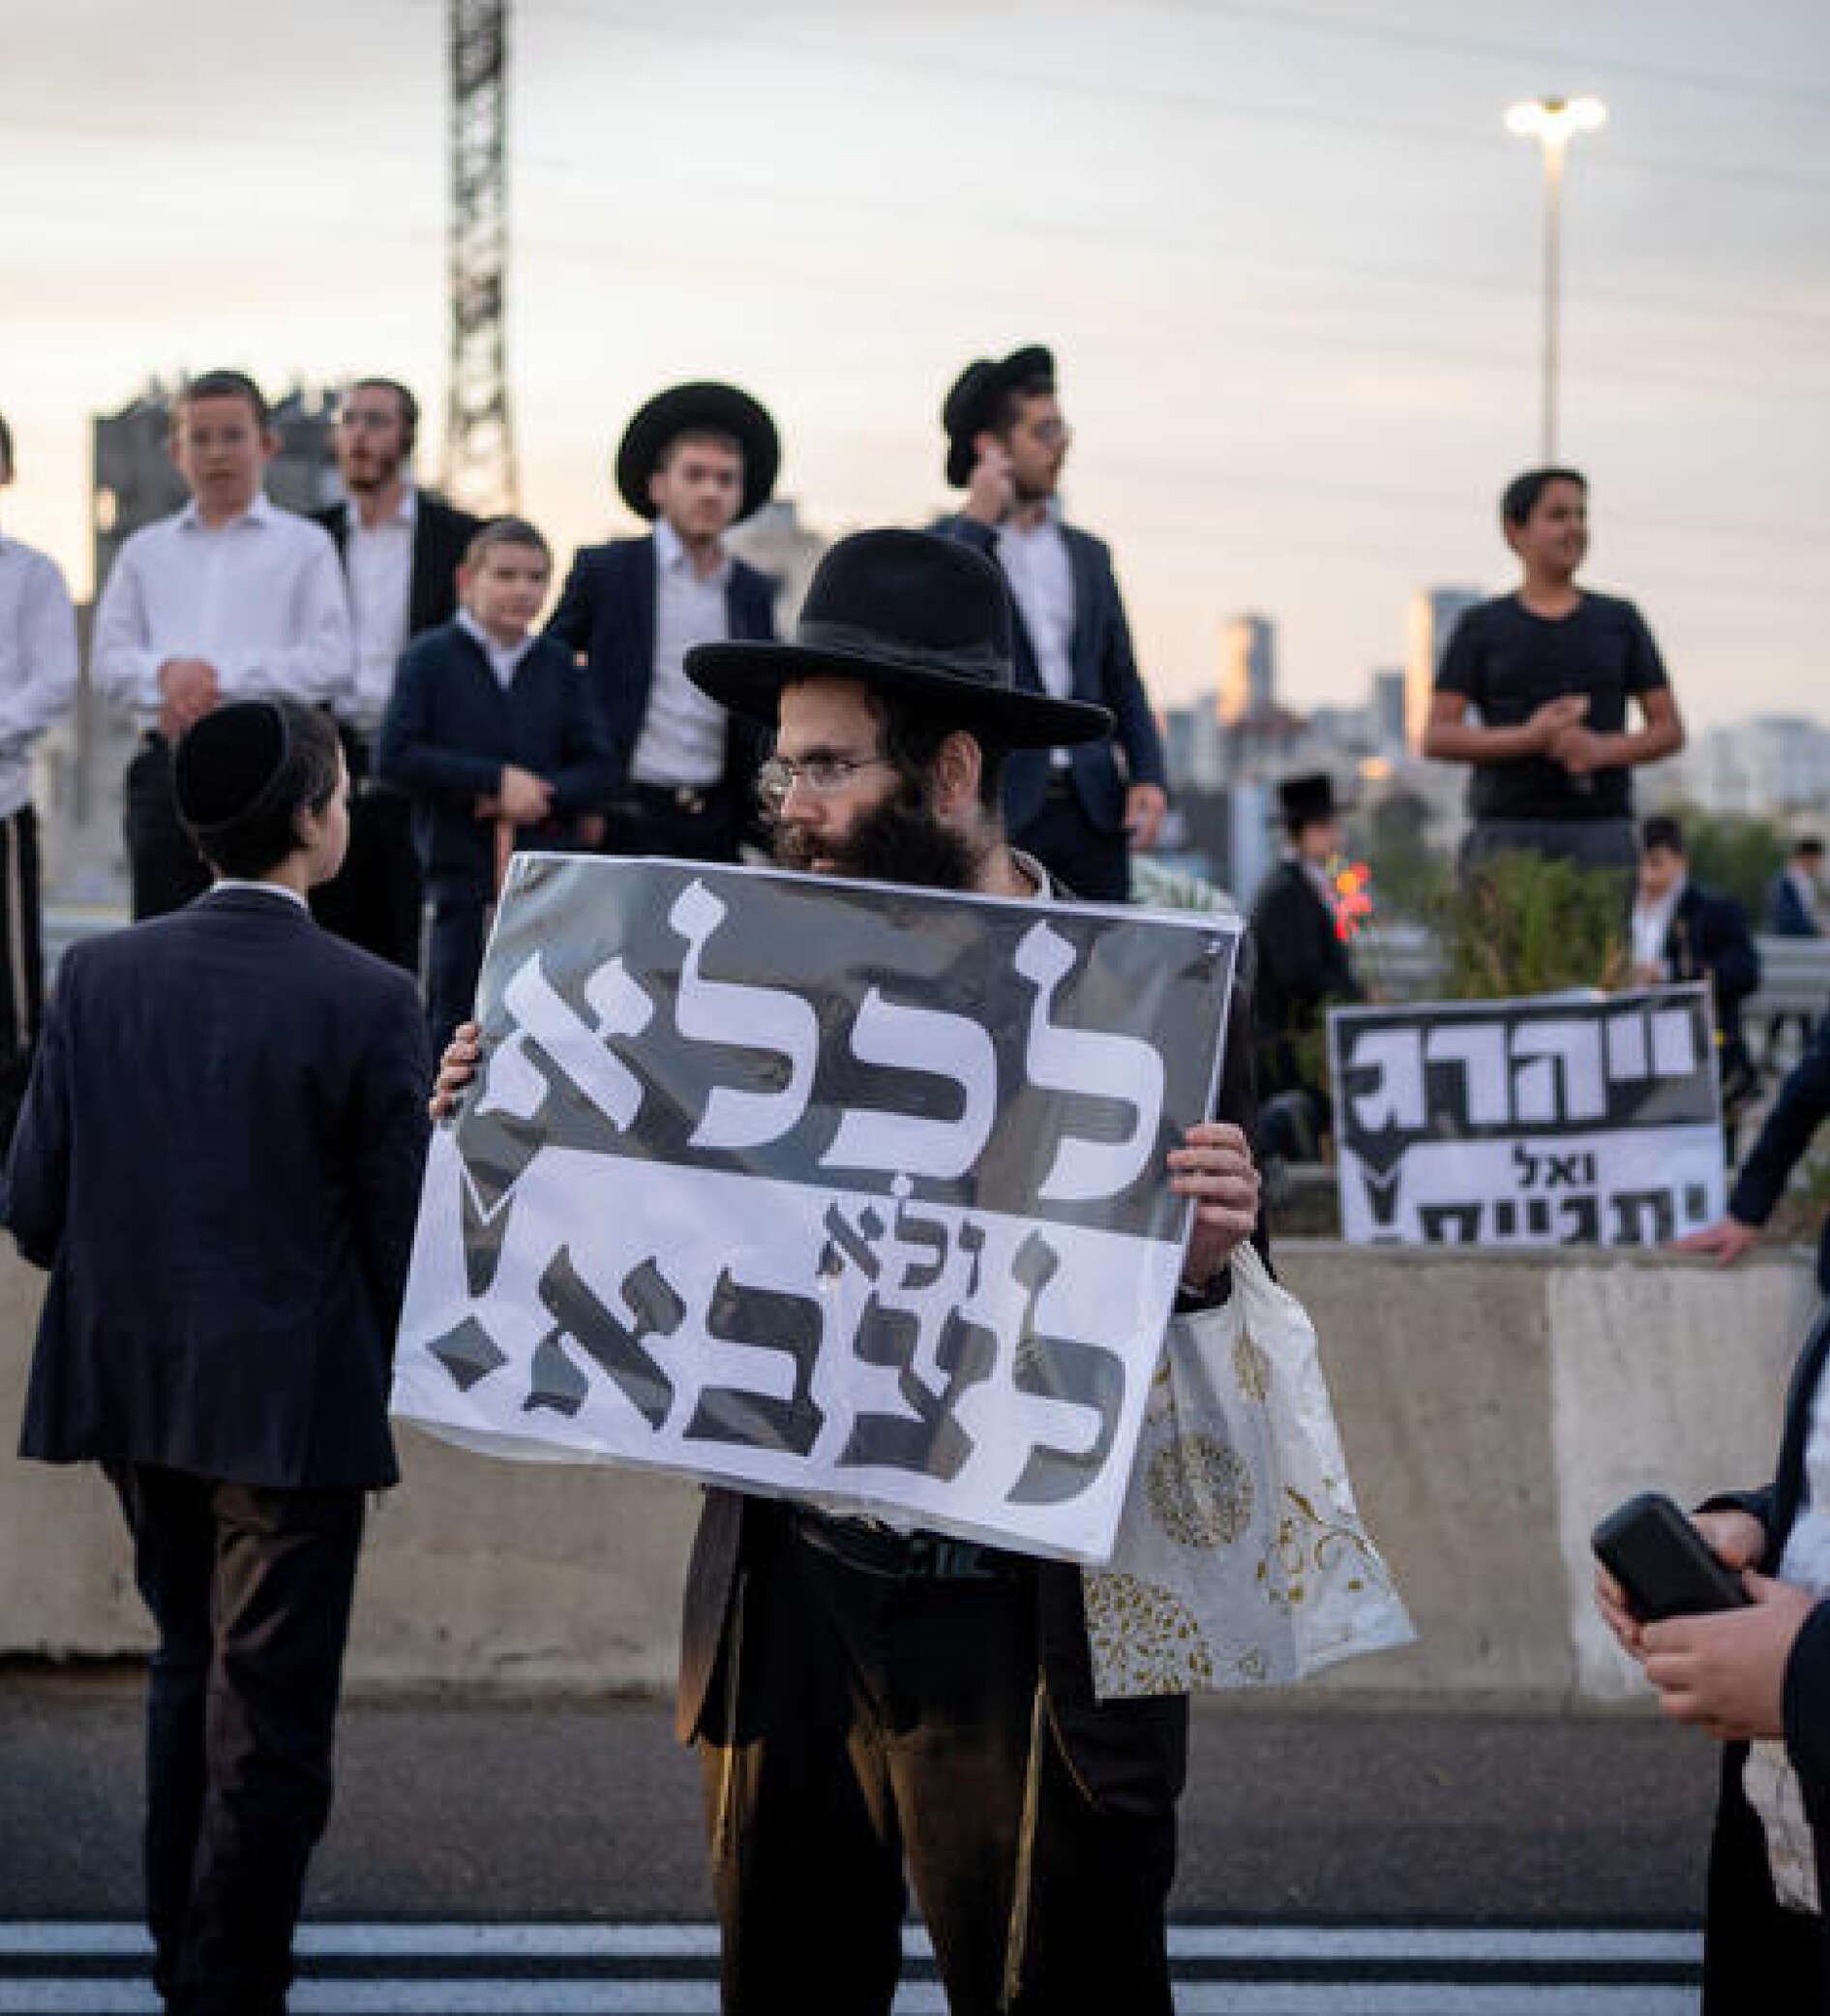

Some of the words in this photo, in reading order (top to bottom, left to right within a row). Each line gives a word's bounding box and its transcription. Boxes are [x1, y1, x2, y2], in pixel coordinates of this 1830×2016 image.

[474, 877, 1164, 1201] לכלא
[1352, 1009, 1695, 1131] ייהרג
[1512, 1143, 1597, 1189] ואל
[816, 1174, 986, 1299] ולא
